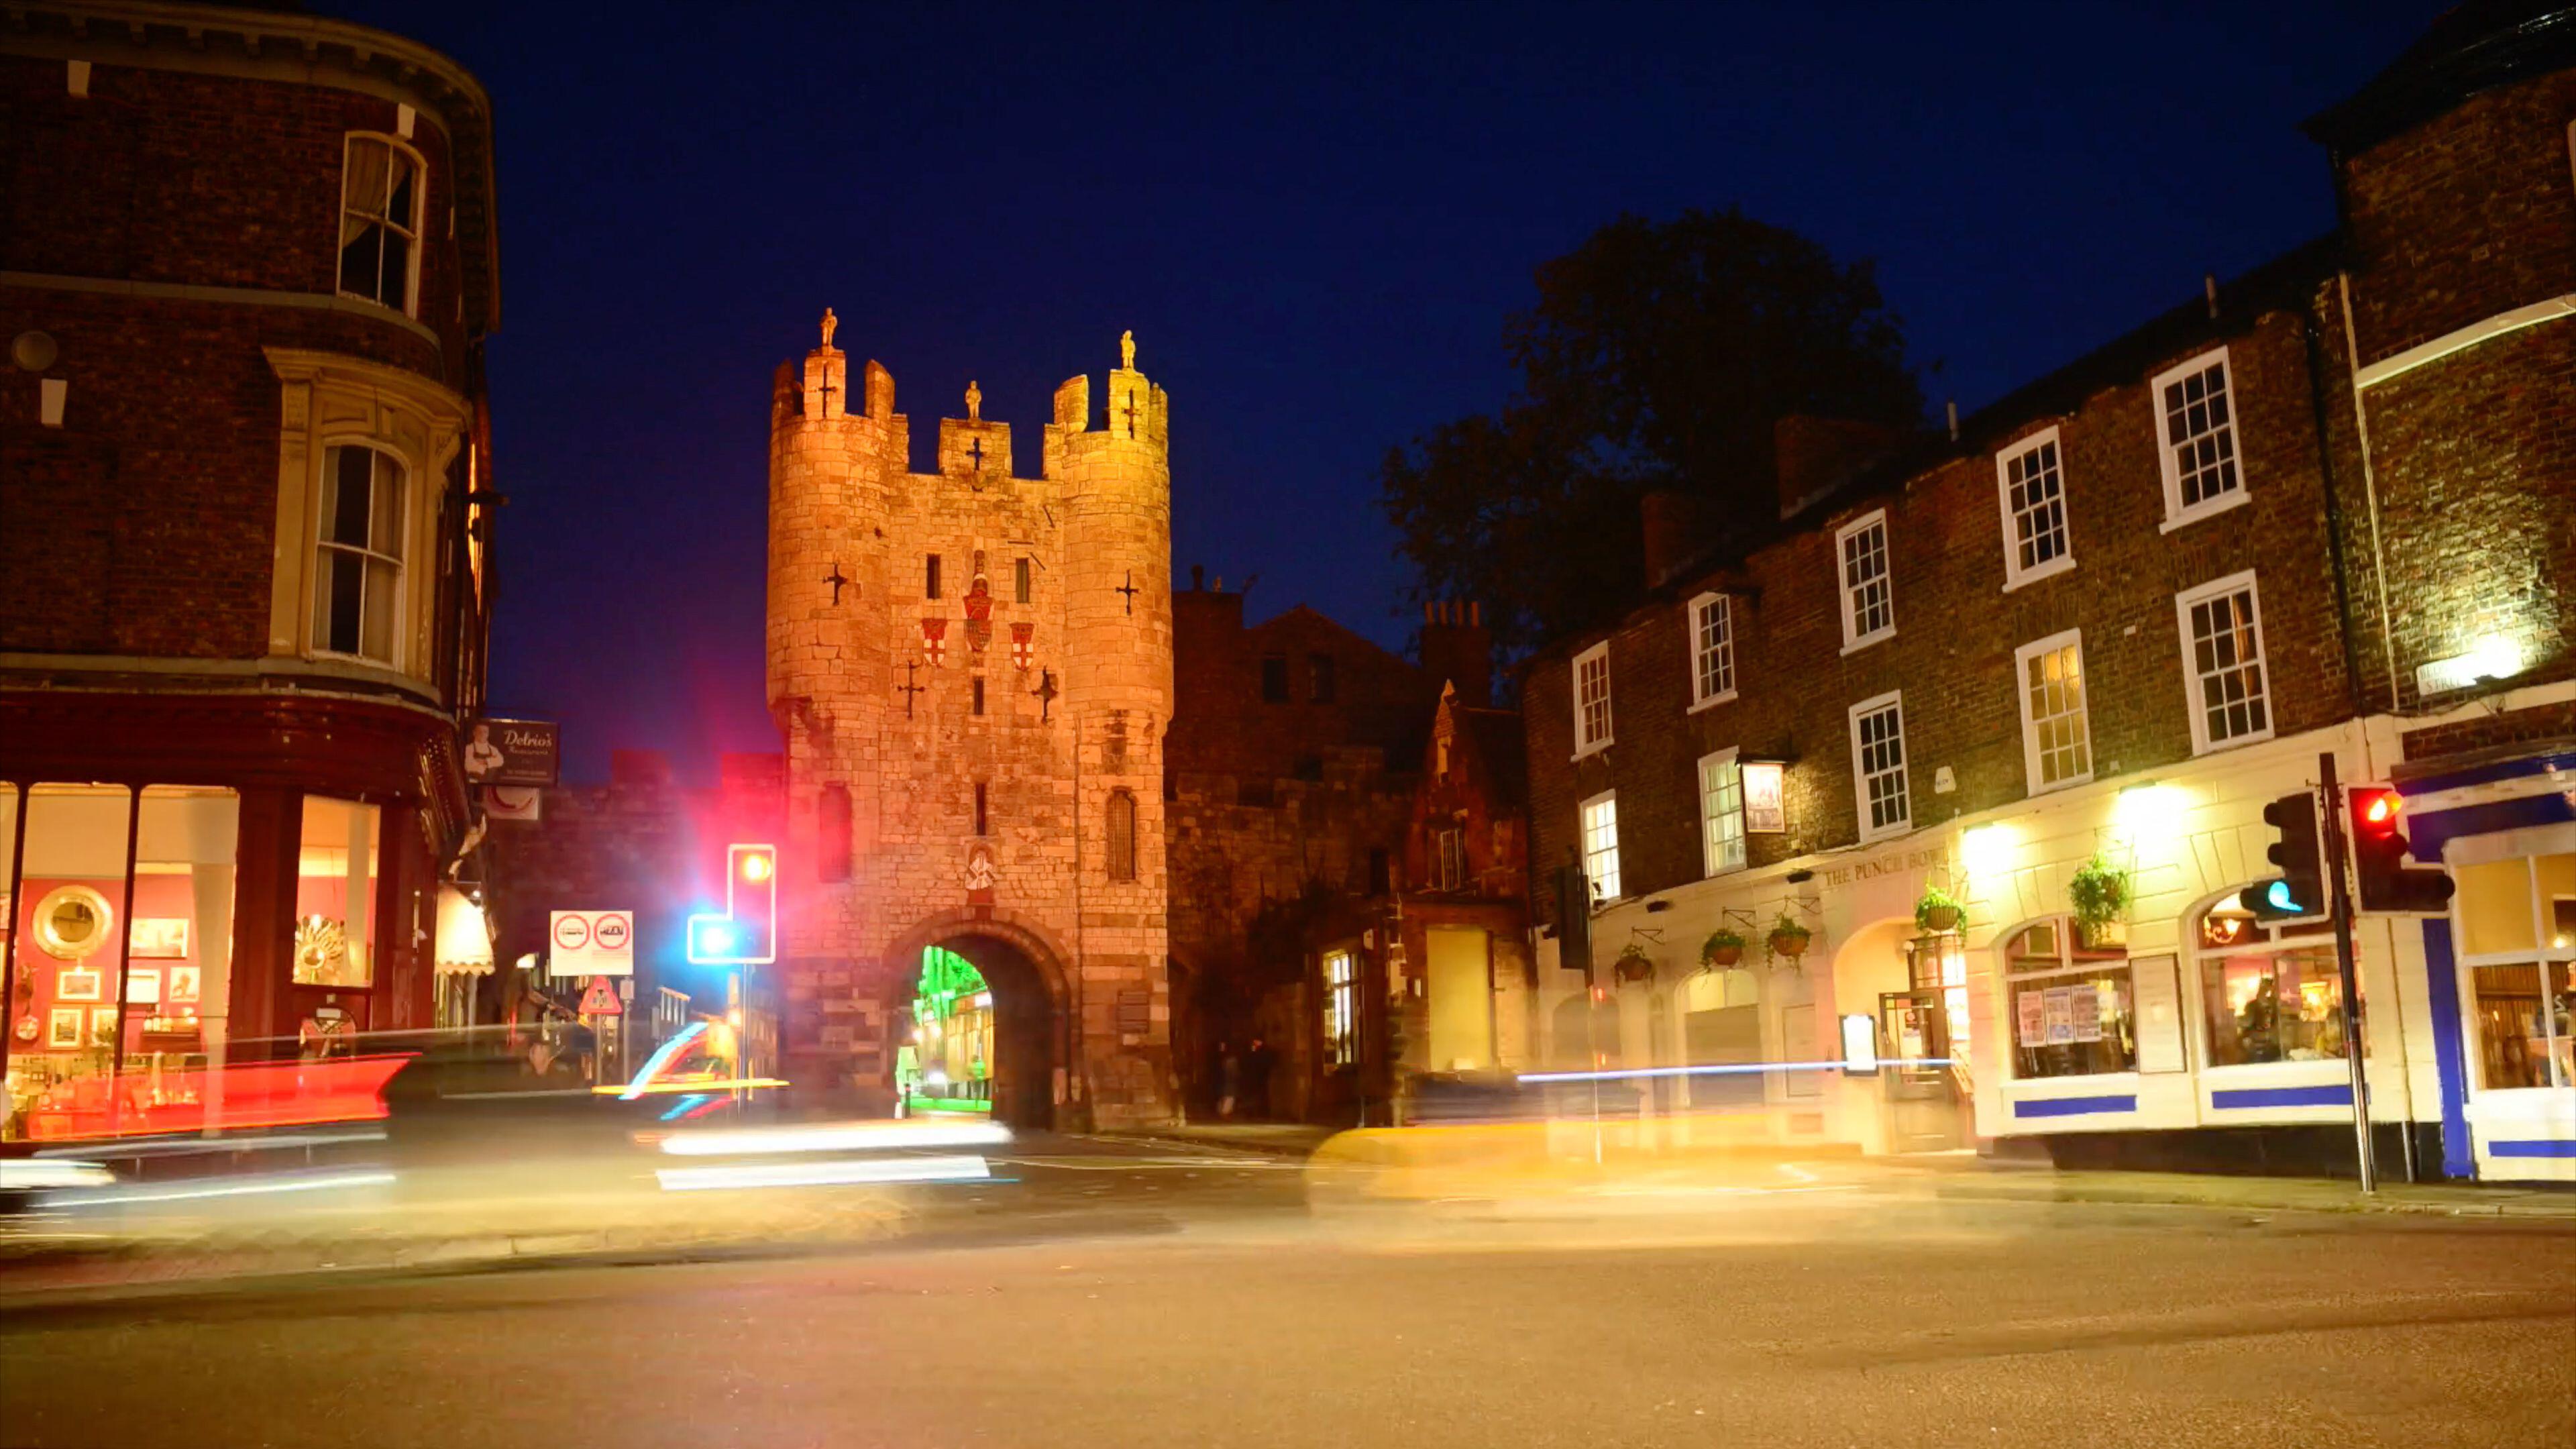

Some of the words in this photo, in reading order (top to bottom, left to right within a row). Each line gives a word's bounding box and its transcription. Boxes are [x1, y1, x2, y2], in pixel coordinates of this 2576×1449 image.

[504, 729, 552, 747] Delrio's
[1825, 868, 1851, 886] THE
[1855, 854, 1903, 881] PUNCH
